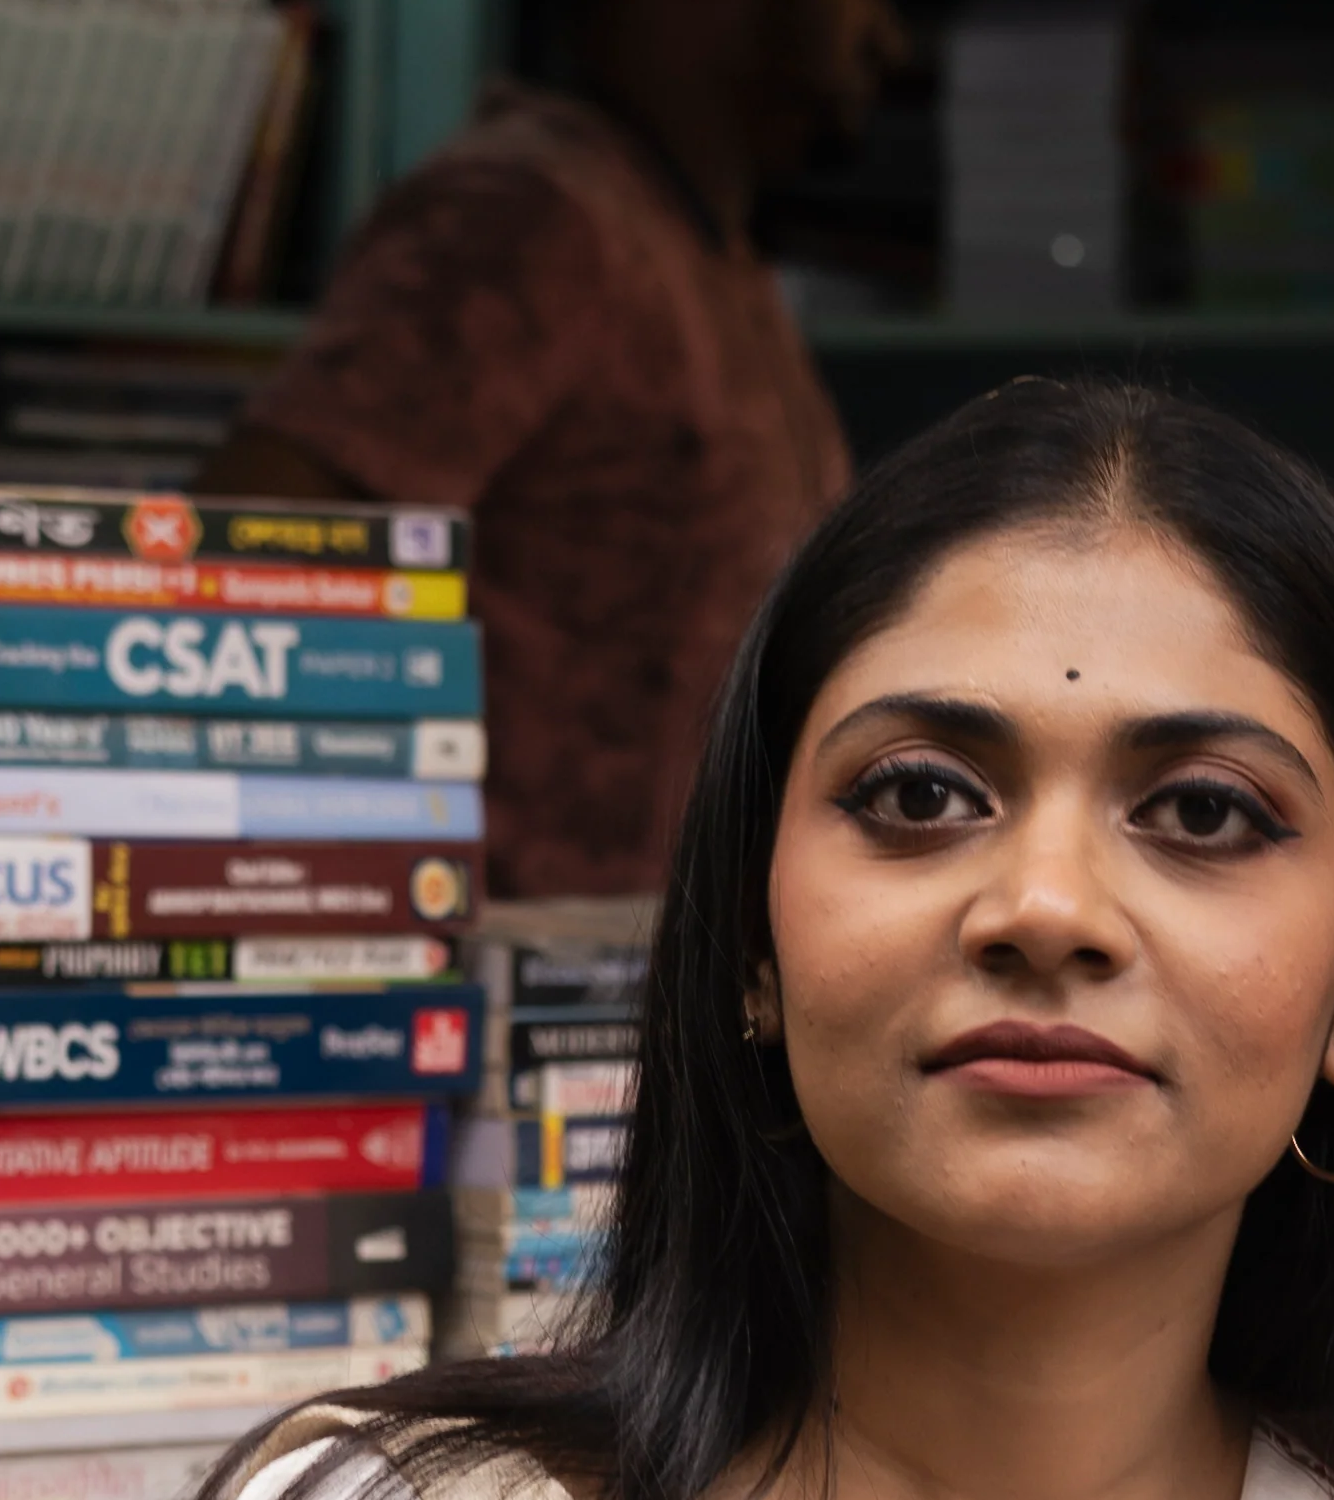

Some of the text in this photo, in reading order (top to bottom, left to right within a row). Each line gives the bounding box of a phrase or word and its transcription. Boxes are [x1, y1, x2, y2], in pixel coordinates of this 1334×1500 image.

[105, 617, 299, 698] CSAT
[85, 1135, 213, 1174] APTITUDE
[95, 1210, 293, 1253] OBJECTIVE
[130, 1251, 270, 1294] Studies
